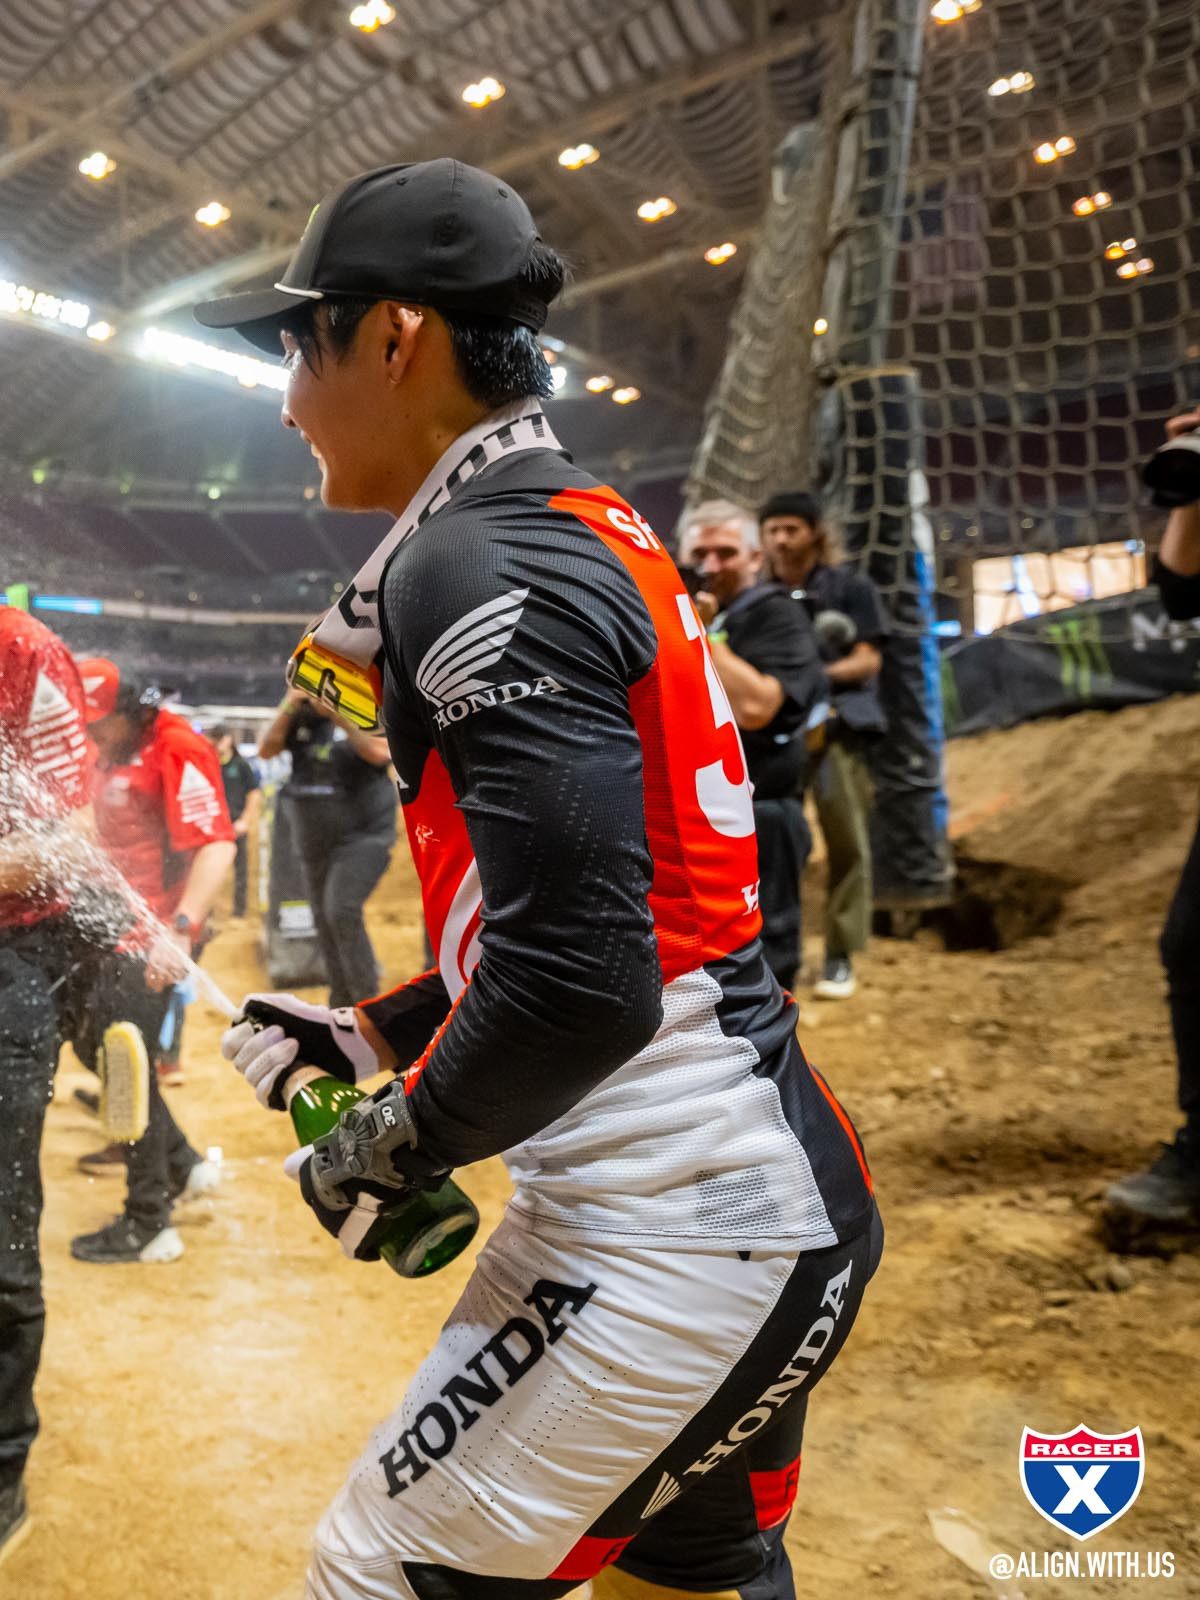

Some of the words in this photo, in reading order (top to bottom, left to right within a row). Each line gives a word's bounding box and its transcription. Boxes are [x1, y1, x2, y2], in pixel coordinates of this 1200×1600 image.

[433, 676, 568, 731] HONDA
[379, 1279, 598, 1498] HONDA
[683, 1260, 853, 1476] HONDA
